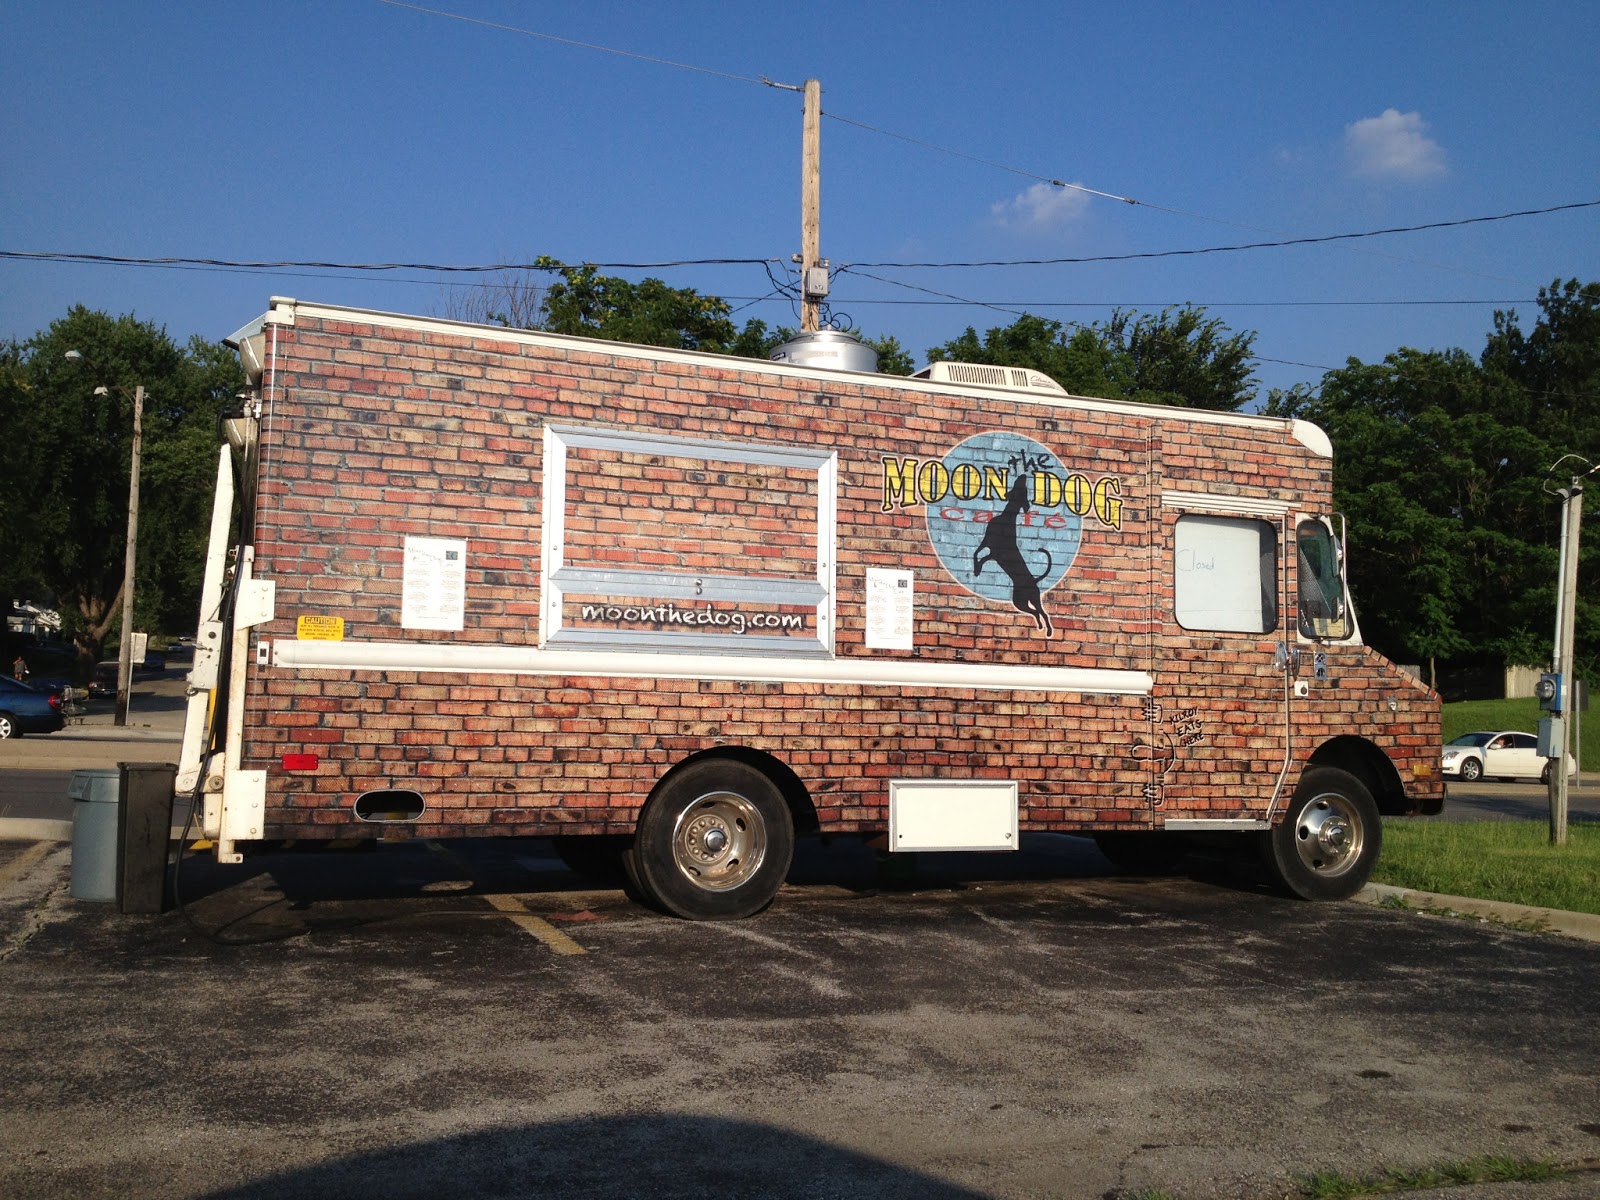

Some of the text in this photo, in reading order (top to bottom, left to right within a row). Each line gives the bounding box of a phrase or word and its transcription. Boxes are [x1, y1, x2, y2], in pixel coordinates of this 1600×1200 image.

[1008, 449, 1054, 477] the
[882, 456, 1124, 531] MOON DOG
[1175, 548, 1215, 571] Closed
[304, 616, 337, 625] CAUTION
[581, 603, 804, 634] moonthedog.com
[1169, 706, 1198, 725] KILROY
[1176, 720, 1202, 737] EATS
[1183, 730, 1204, 747] HERE
